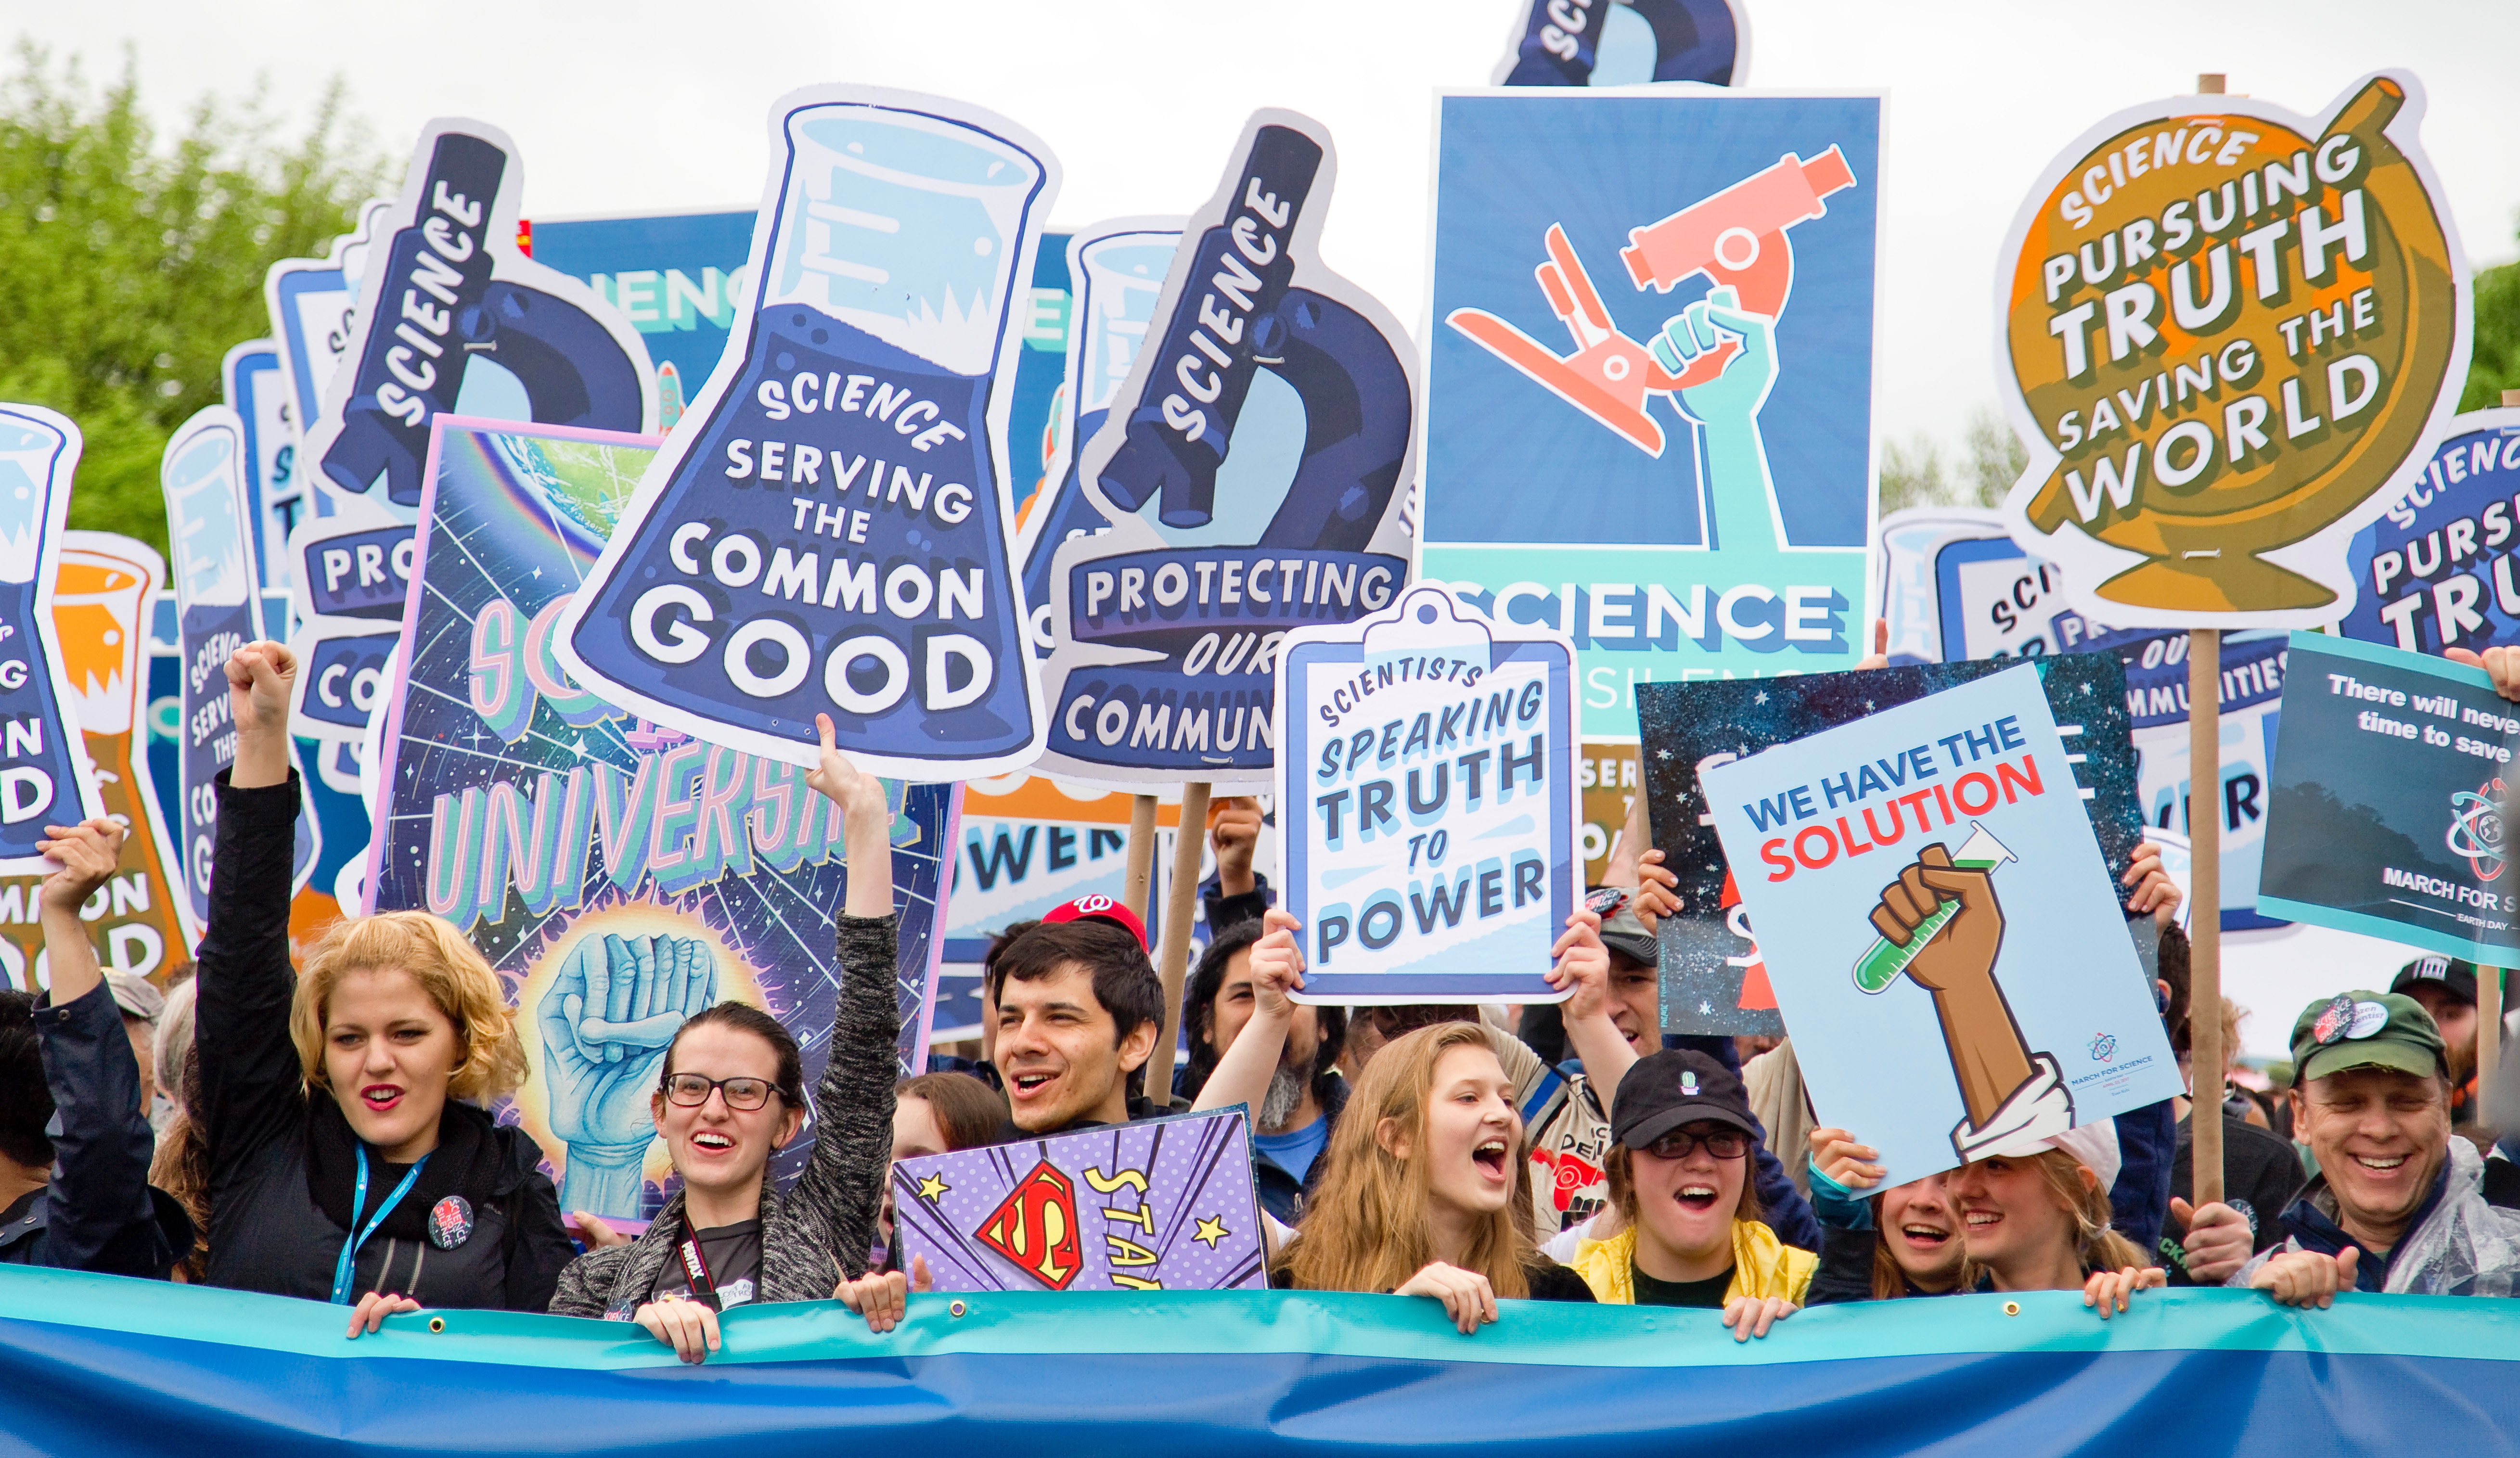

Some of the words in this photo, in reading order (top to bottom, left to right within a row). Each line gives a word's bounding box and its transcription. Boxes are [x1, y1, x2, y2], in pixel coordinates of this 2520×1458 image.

[2061, 128, 2259, 230] SCIENCE
[2043, 134, 2361, 304] PURSUING
[376, 180, 481, 427] SCIENCE
[1162, 177, 1291, 442] SCIENCE
[2050, 189, 2367, 381] TRUTH
[2057, 339, 2256, 451] SAVING
[2279, 288, 2374, 358] THE
[758, 371, 966, 452] SCIENCE
[2063, 354, 2380, 524] WORLD
[725, 438, 973, 523] SERVING
[793, 498, 871, 543] THE
[669, 522, 984, 620] COMMON
[1087, 559, 1393, 616] PROTECTING
[630, 584, 993, 714] GOOD
[1183, 631, 1278, 676] OUR
[1320, 657, 1484, 728] SCIENTISTS
[2328, 673, 2406, 706] There
[2413, 694, 2458, 719] will
[2462, 706, 2520, 735] neve
[1318, 680, 1543, 779] SPEAKING
[2359, 711, 2418, 740] time
[2423, 724, 2451, 747] to
[2455, 735, 2511, 763] save
[1317, 733, 1544, 841] TRUTH
[1743, 784, 1819, 833] WE
[1822, 744, 1940, 810] HAVE
[1938, 714, 2026, 768] THE
[1408, 829, 1448, 868] TO
[1760, 753, 2045, 882] SOLUTION
[1318, 858, 1545, 964] POWER
[2384, 867, 2456, 900] MARCH
[2456, 886, 2498, 911] FOR
[2456, 913, 2486, 928] EARTH
[2487, 920, 2509, 931] DAY
[2315, 998, 2352, 1030] SCIENCE
[2318, 1013, 2353, 1042] SILENCE
[2326, 1012, 2341, 1029] NOT
[2072, 1072, 2100, 1086] MARCH
[2101, 1067, 2118, 1076] FOR
[2119, 1056, 2153, 1071] SCIENCE
[436, 1207, 453, 1248] SILENCE
[446, 1213, 456, 1234] NOT
[449, 1199, 466, 1245] SCIENCE
[681, 1240, 704, 1280] PENTAX
